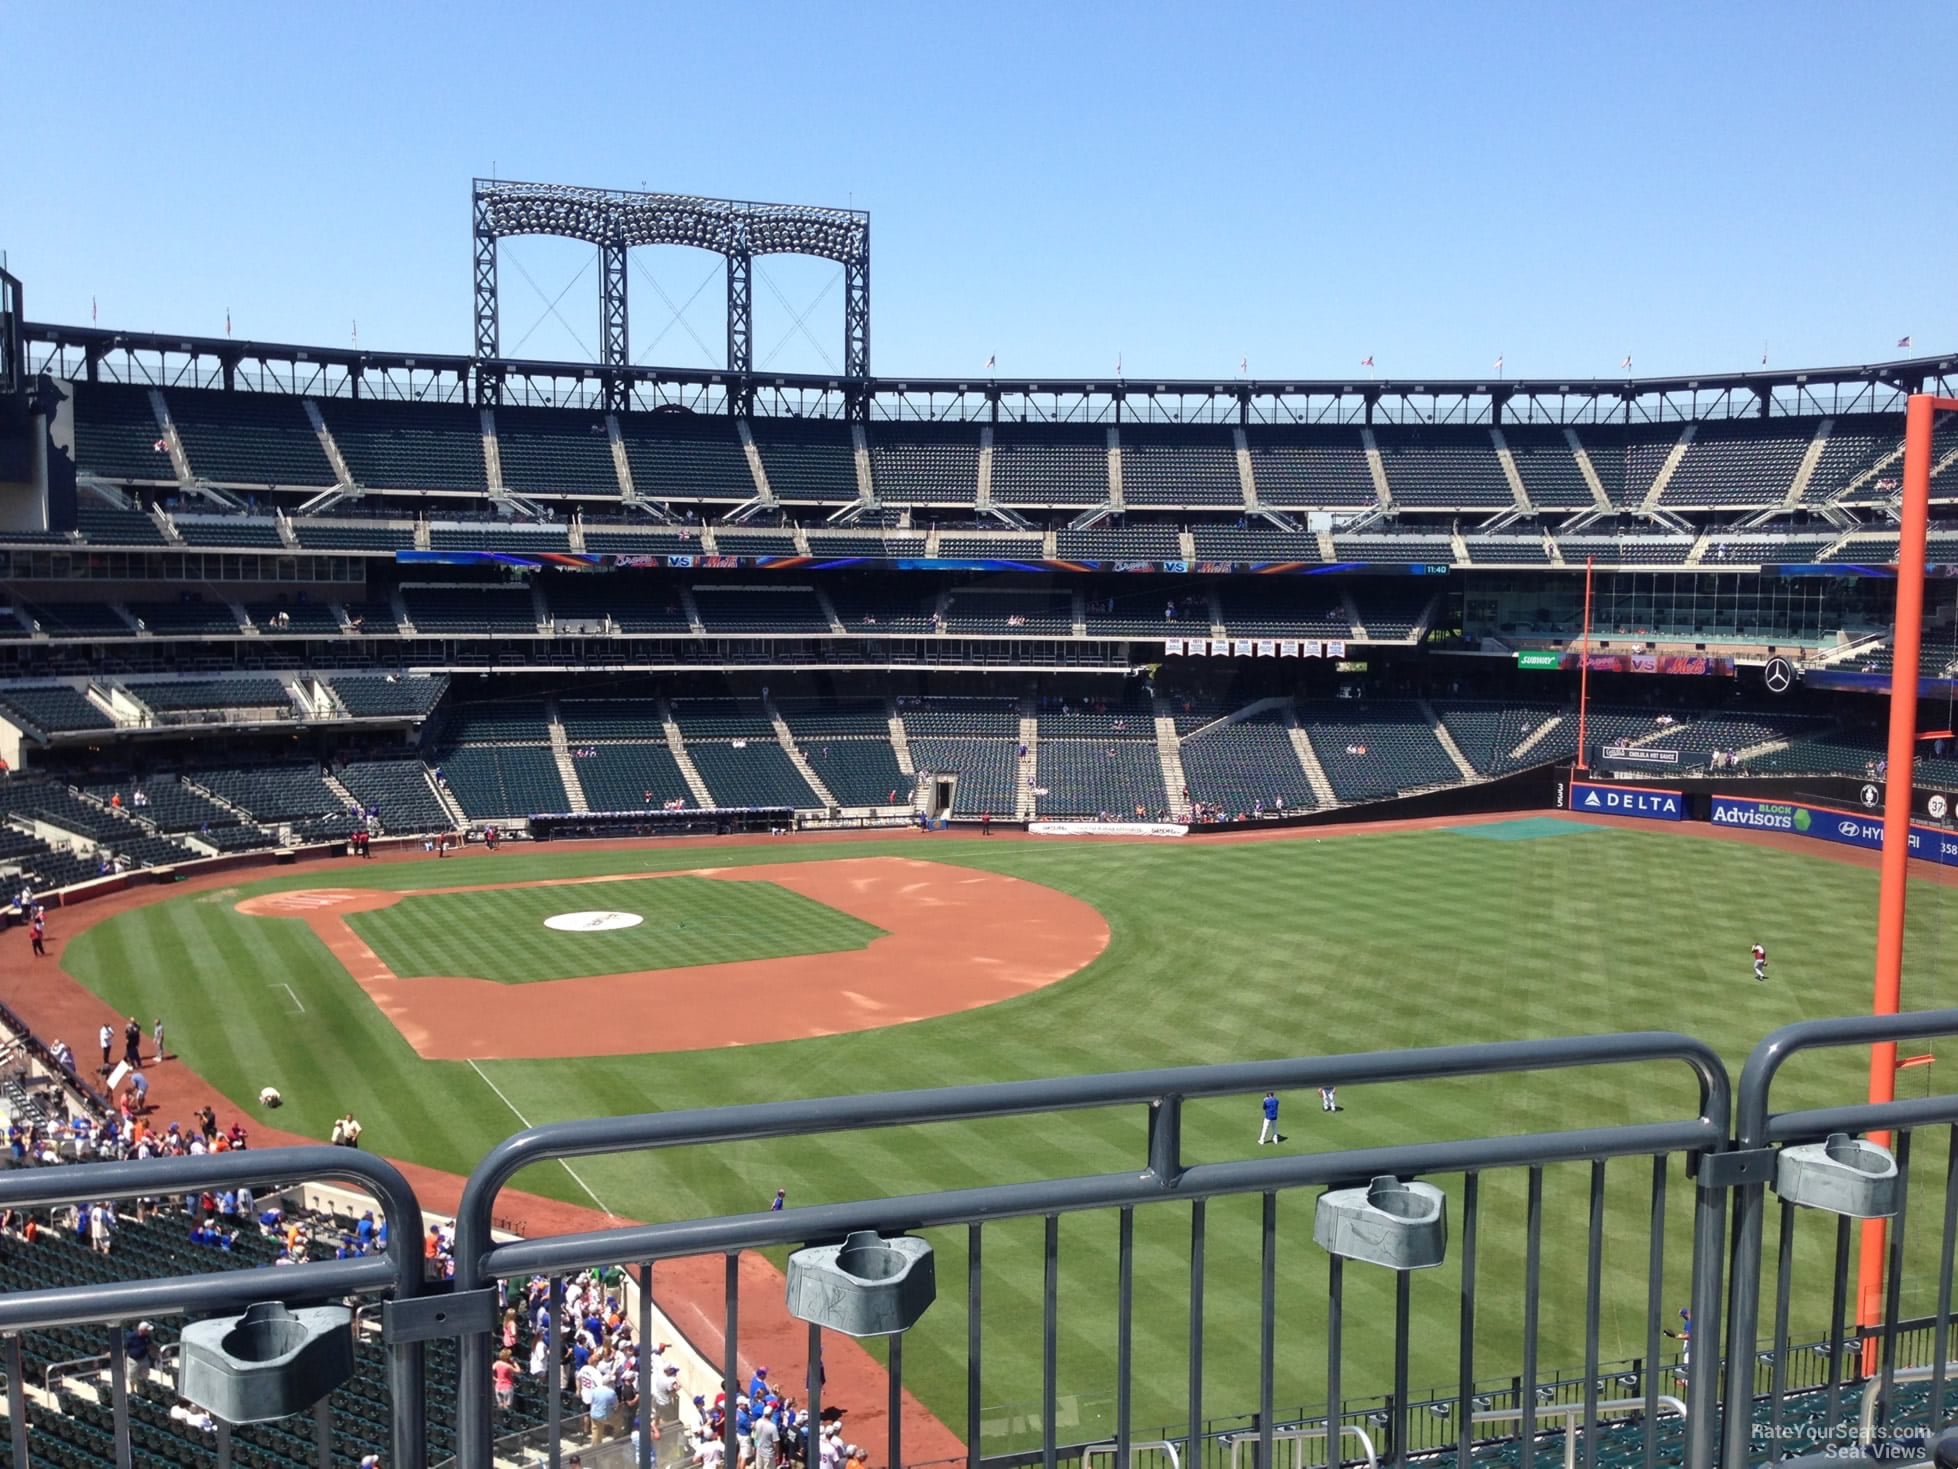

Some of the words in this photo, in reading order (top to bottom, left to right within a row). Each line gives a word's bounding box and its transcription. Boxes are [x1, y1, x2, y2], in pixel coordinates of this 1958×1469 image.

[669, 556, 690, 568] VS
[1165, 562, 1185, 572] VS
[1427, 565, 1447, 574] 11:40
[1520, 656, 1556, 665] SUBWAY
[1632, 659, 1655, 670] VS
[1607, 793, 1676, 813] DELTA
[1931, 801, 1943, 813] 37
[1758, 804, 1792, 815] BLOCK
[1712, 806, 1792, 829] Advisors
[1862, 825, 1920, 849] HYAI
[1939, 842, 1958, 856] 358
